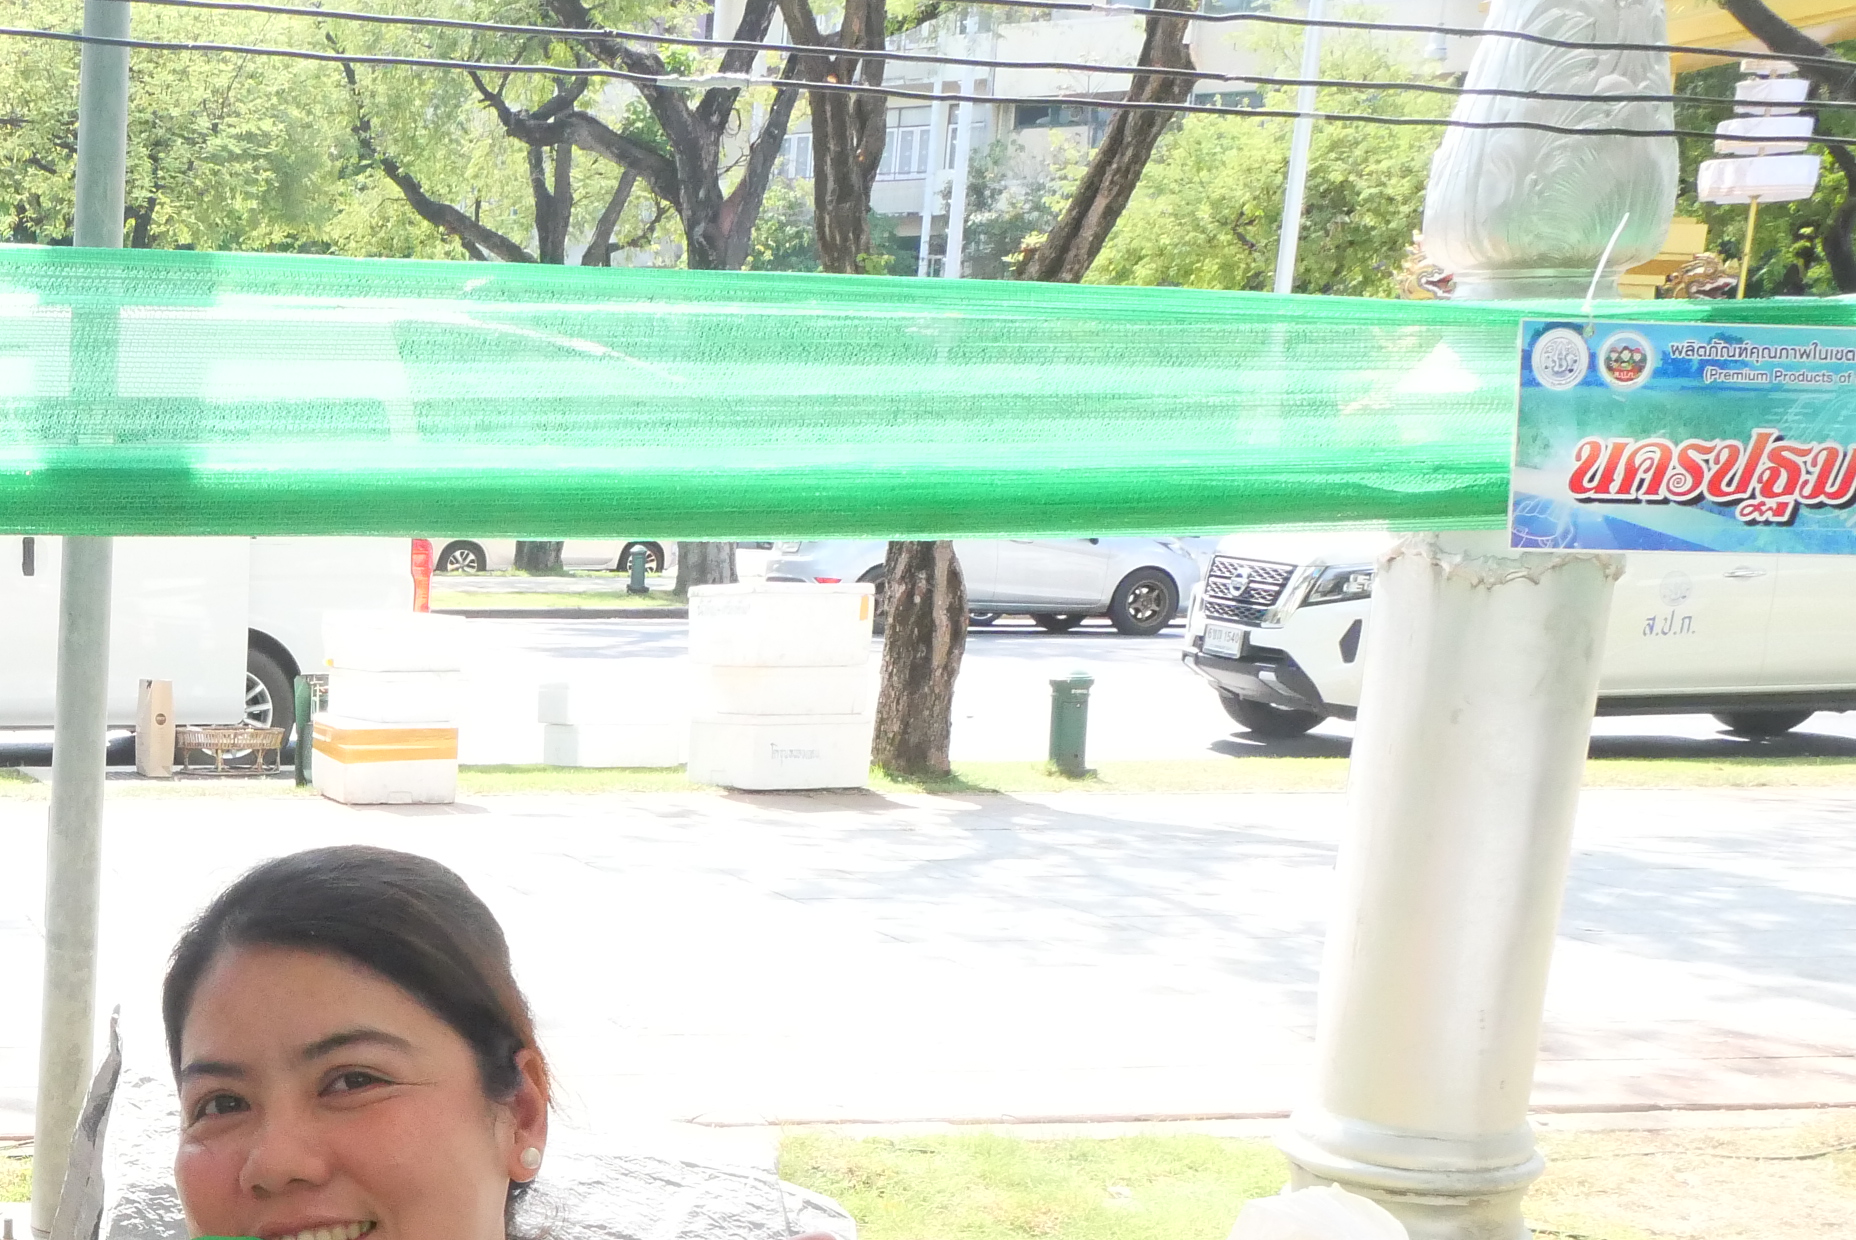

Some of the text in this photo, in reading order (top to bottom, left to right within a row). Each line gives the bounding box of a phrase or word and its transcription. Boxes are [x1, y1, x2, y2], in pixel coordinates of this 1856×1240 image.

[1703, 369, 1853, 384] (Premium Products of
[1567, 427, 1856, 522] นครปฐม
[1641, 608, 1697, 637] ส.ป.ก.
